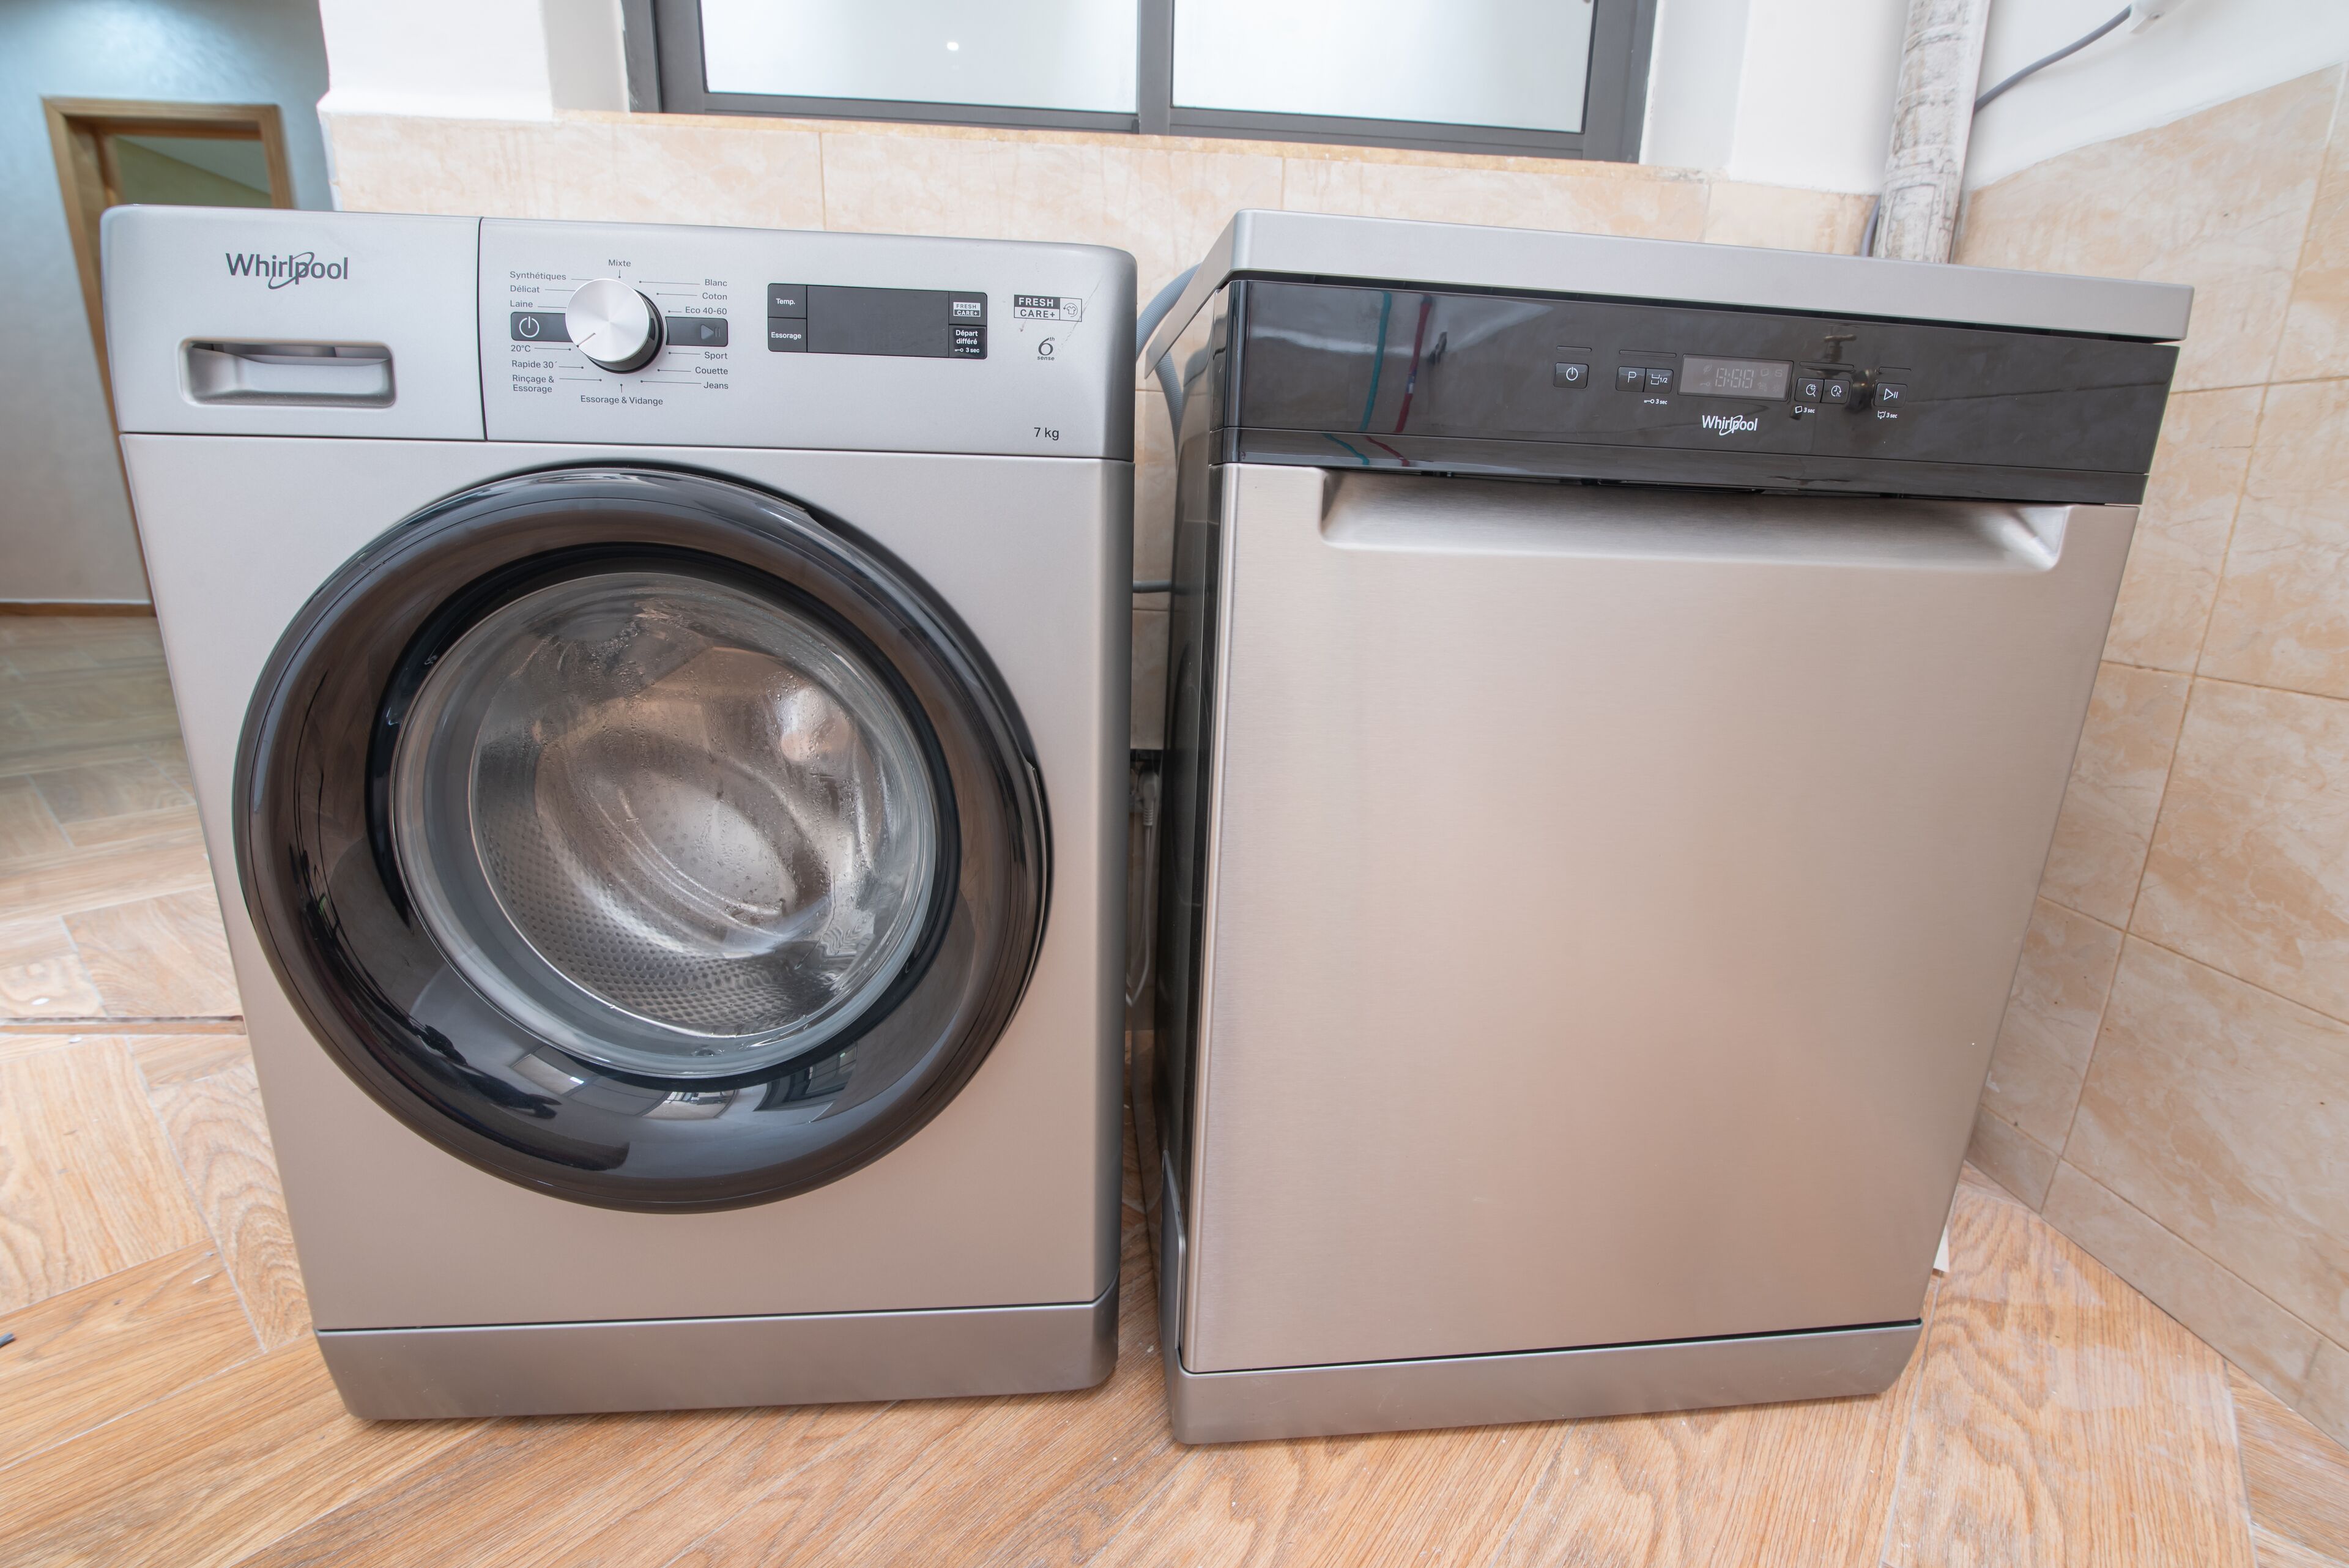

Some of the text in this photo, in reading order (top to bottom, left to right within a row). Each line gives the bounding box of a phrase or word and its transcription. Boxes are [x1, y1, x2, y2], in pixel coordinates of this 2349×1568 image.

[608, 259, 631, 267] Mixte
[226, 251, 349, 289] Whirlpool
[510, 270, 566, 281] Synthétiques
[705, 278, 727, 287] Blanc
[510, 284, 540, 293] Délicat
[702, 292, 727, 300] Coton
[510, 299, 533, 308] Laine
[1019, 297, 1054, 307] FRESH
[685, 306, 700, 314] Eco
[1020, 309, 1055, 318] CARE+
[511, 344, 531, 353] 20°C
[704, 351, 728, 361] Sport
[511, 360, 541, 370] Rapide
[695, 366, 729, 375] Couette
[512, 374, 546, 385] Rinçage
[1627, 371, 1637, 383] P
[513, 384, 552, 393] Essorage
[581, 395, 620, 405] Essorage
[629, 396, 663, 407] Vidange
[1702, 415, 1758, 436] Whirlpool
[1034, 427, 1059, 440] 7 kg
